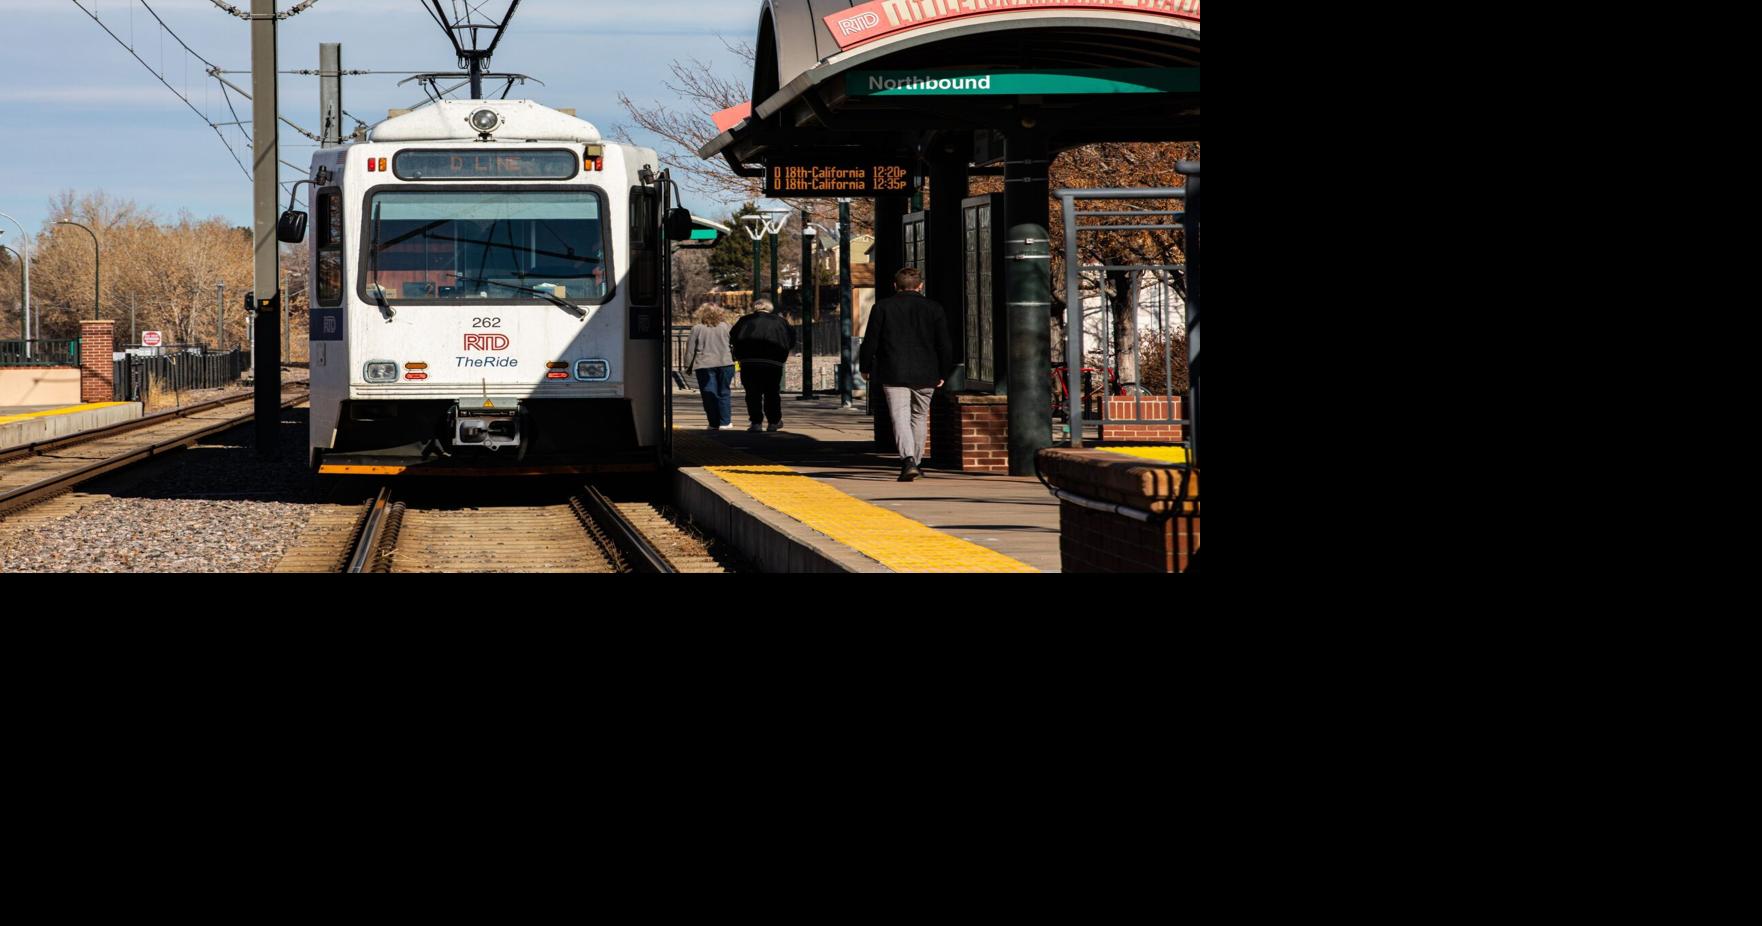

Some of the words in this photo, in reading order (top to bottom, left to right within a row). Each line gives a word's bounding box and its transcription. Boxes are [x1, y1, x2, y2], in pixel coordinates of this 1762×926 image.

[838, 11, 880, 37] RTD
[868, 74, 991, 91] Northbound
[450, 155, 464, 173] D
[475, 155, 521, 173] LINE
[785, 166, 865, 179] 18th-California
[785, 178, 865, 190] 18th-California
[323, 315, 337, 334] RTD
[472, 317, 501, 328] 262
[463, 333, 510, 351] RTD
[456, 356, 518, 368] TheRide
